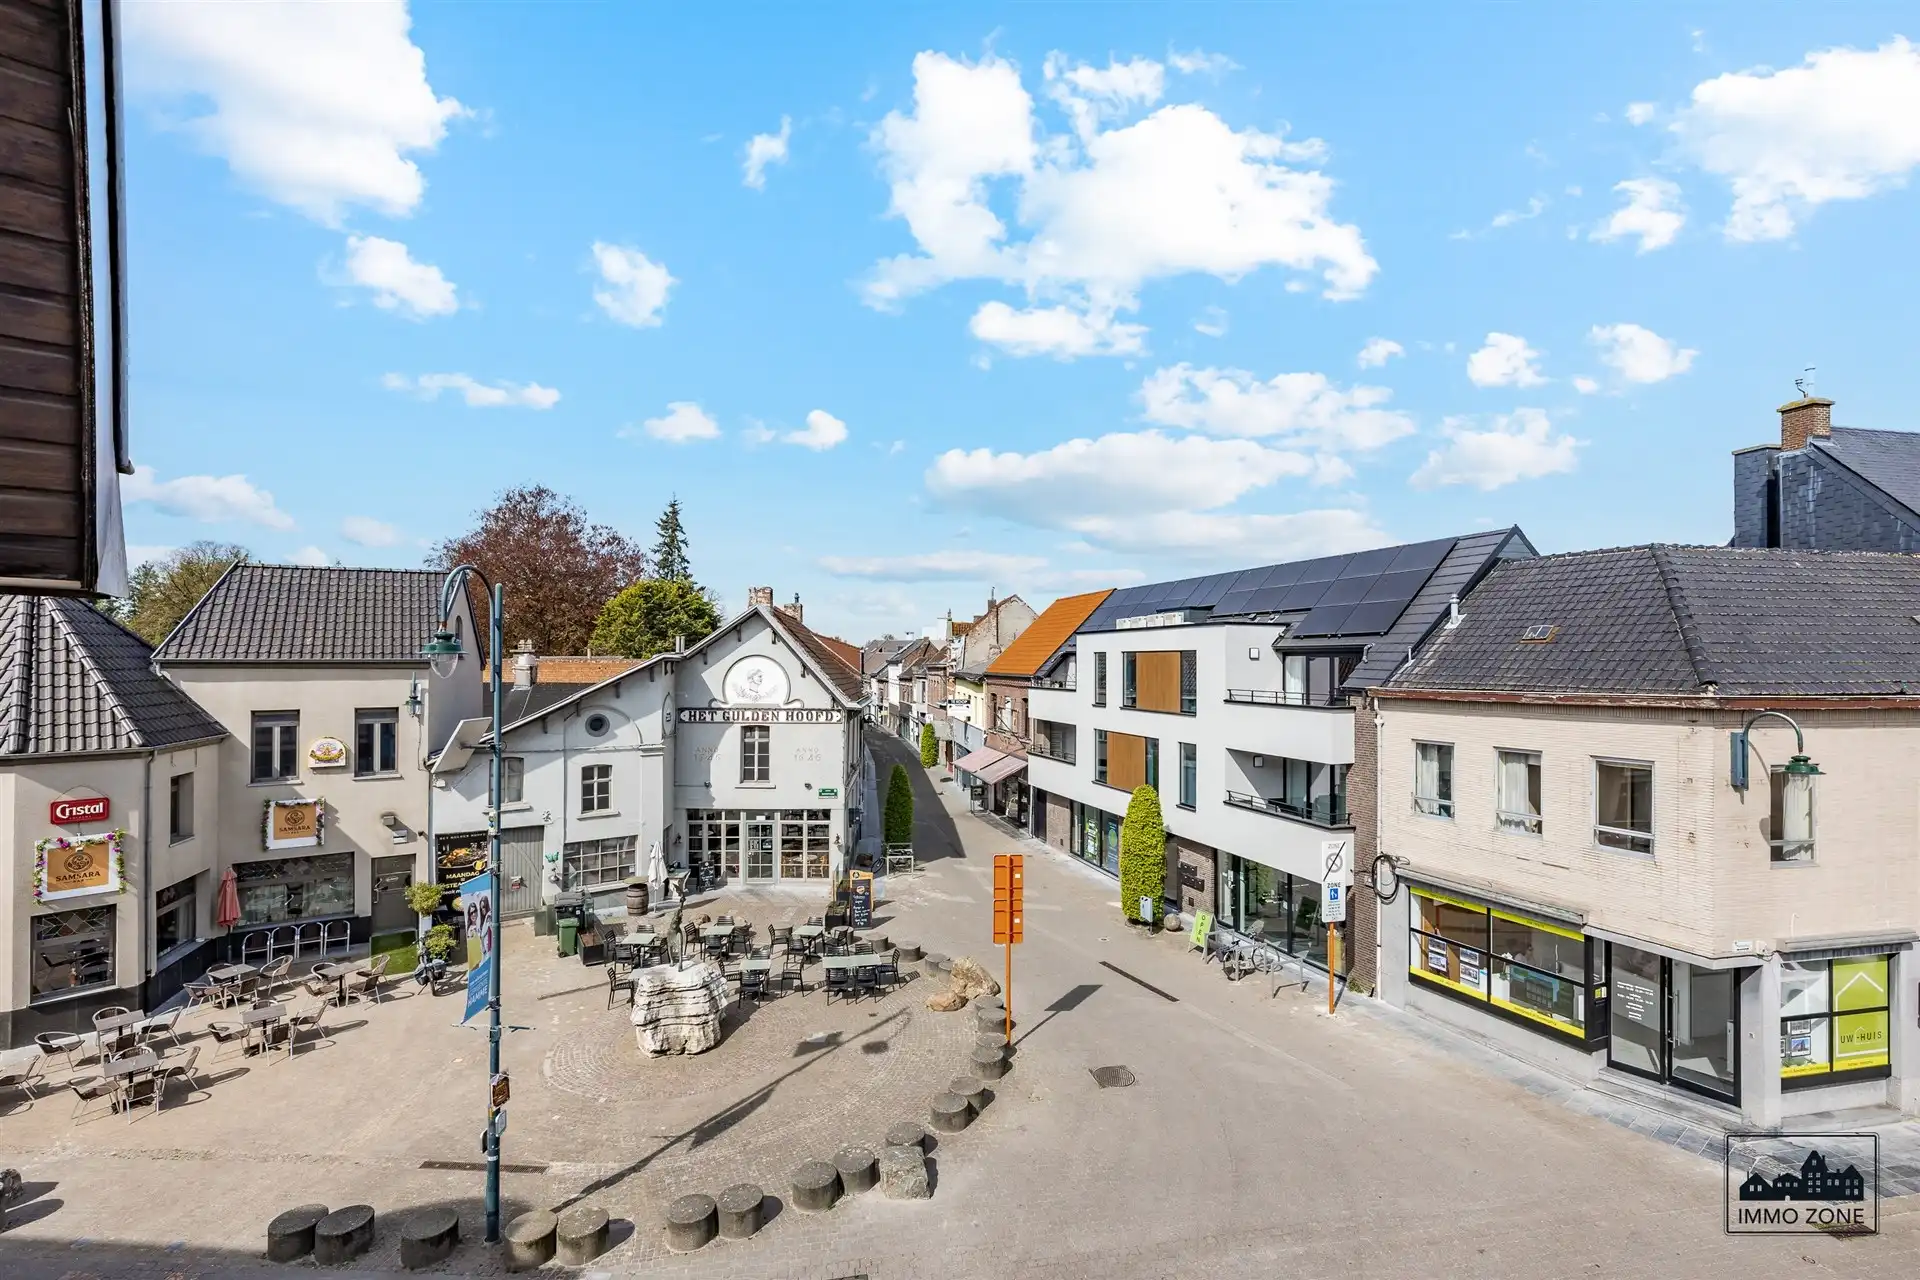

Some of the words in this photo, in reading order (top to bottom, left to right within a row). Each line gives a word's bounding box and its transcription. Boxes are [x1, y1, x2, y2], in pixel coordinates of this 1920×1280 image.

[688, 710, 718, 722] HET
[722, 710, 781, 722] GULDEN
[785, 710, 835, 722] HOOFD
[56, 802, 104, 819] Cristal
[279, 825, 311, 833] SAMSARA
[55, 870, 101, 883] SAMSARA
[446, 870, 480, 879] MAANDAG
[1195, 914, 1206, 943] OPEN
